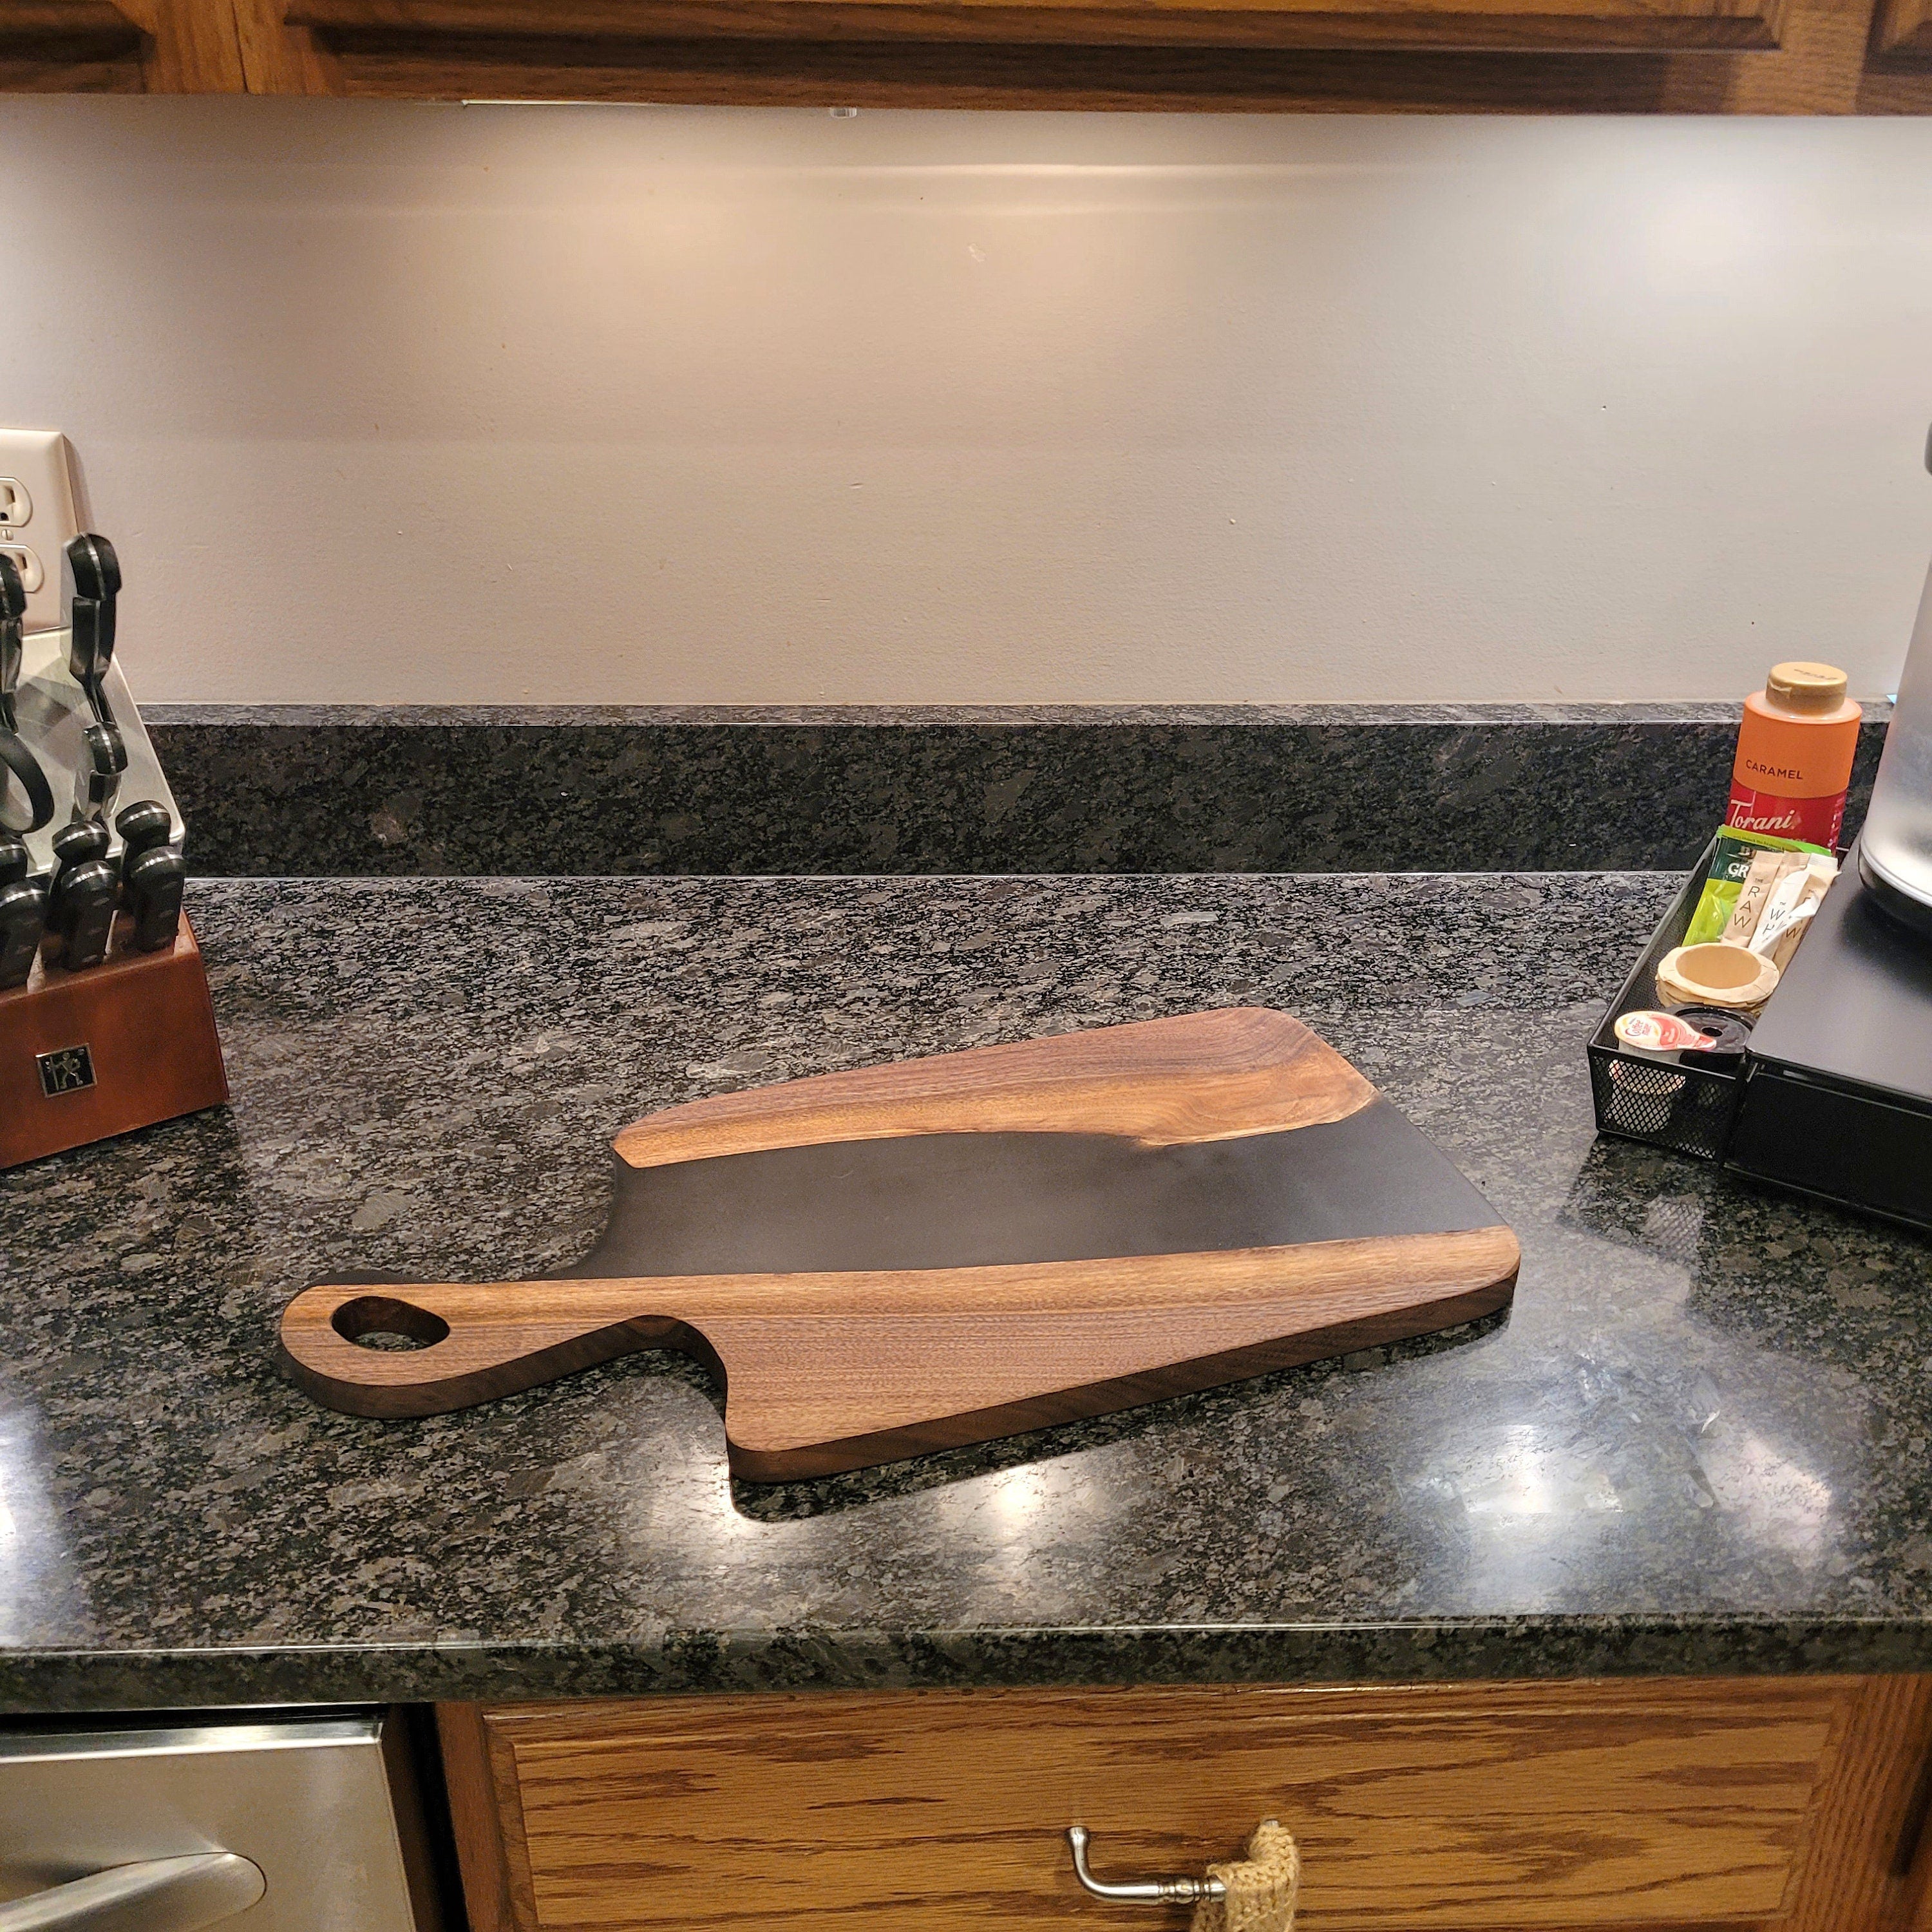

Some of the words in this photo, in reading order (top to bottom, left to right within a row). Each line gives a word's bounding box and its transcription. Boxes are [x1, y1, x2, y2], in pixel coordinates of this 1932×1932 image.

[1746, 759, 1803, 780] CARAMEL
[1730, 799, 1795, 830] Torani
[1734, 886, 1760, 929] RAW
